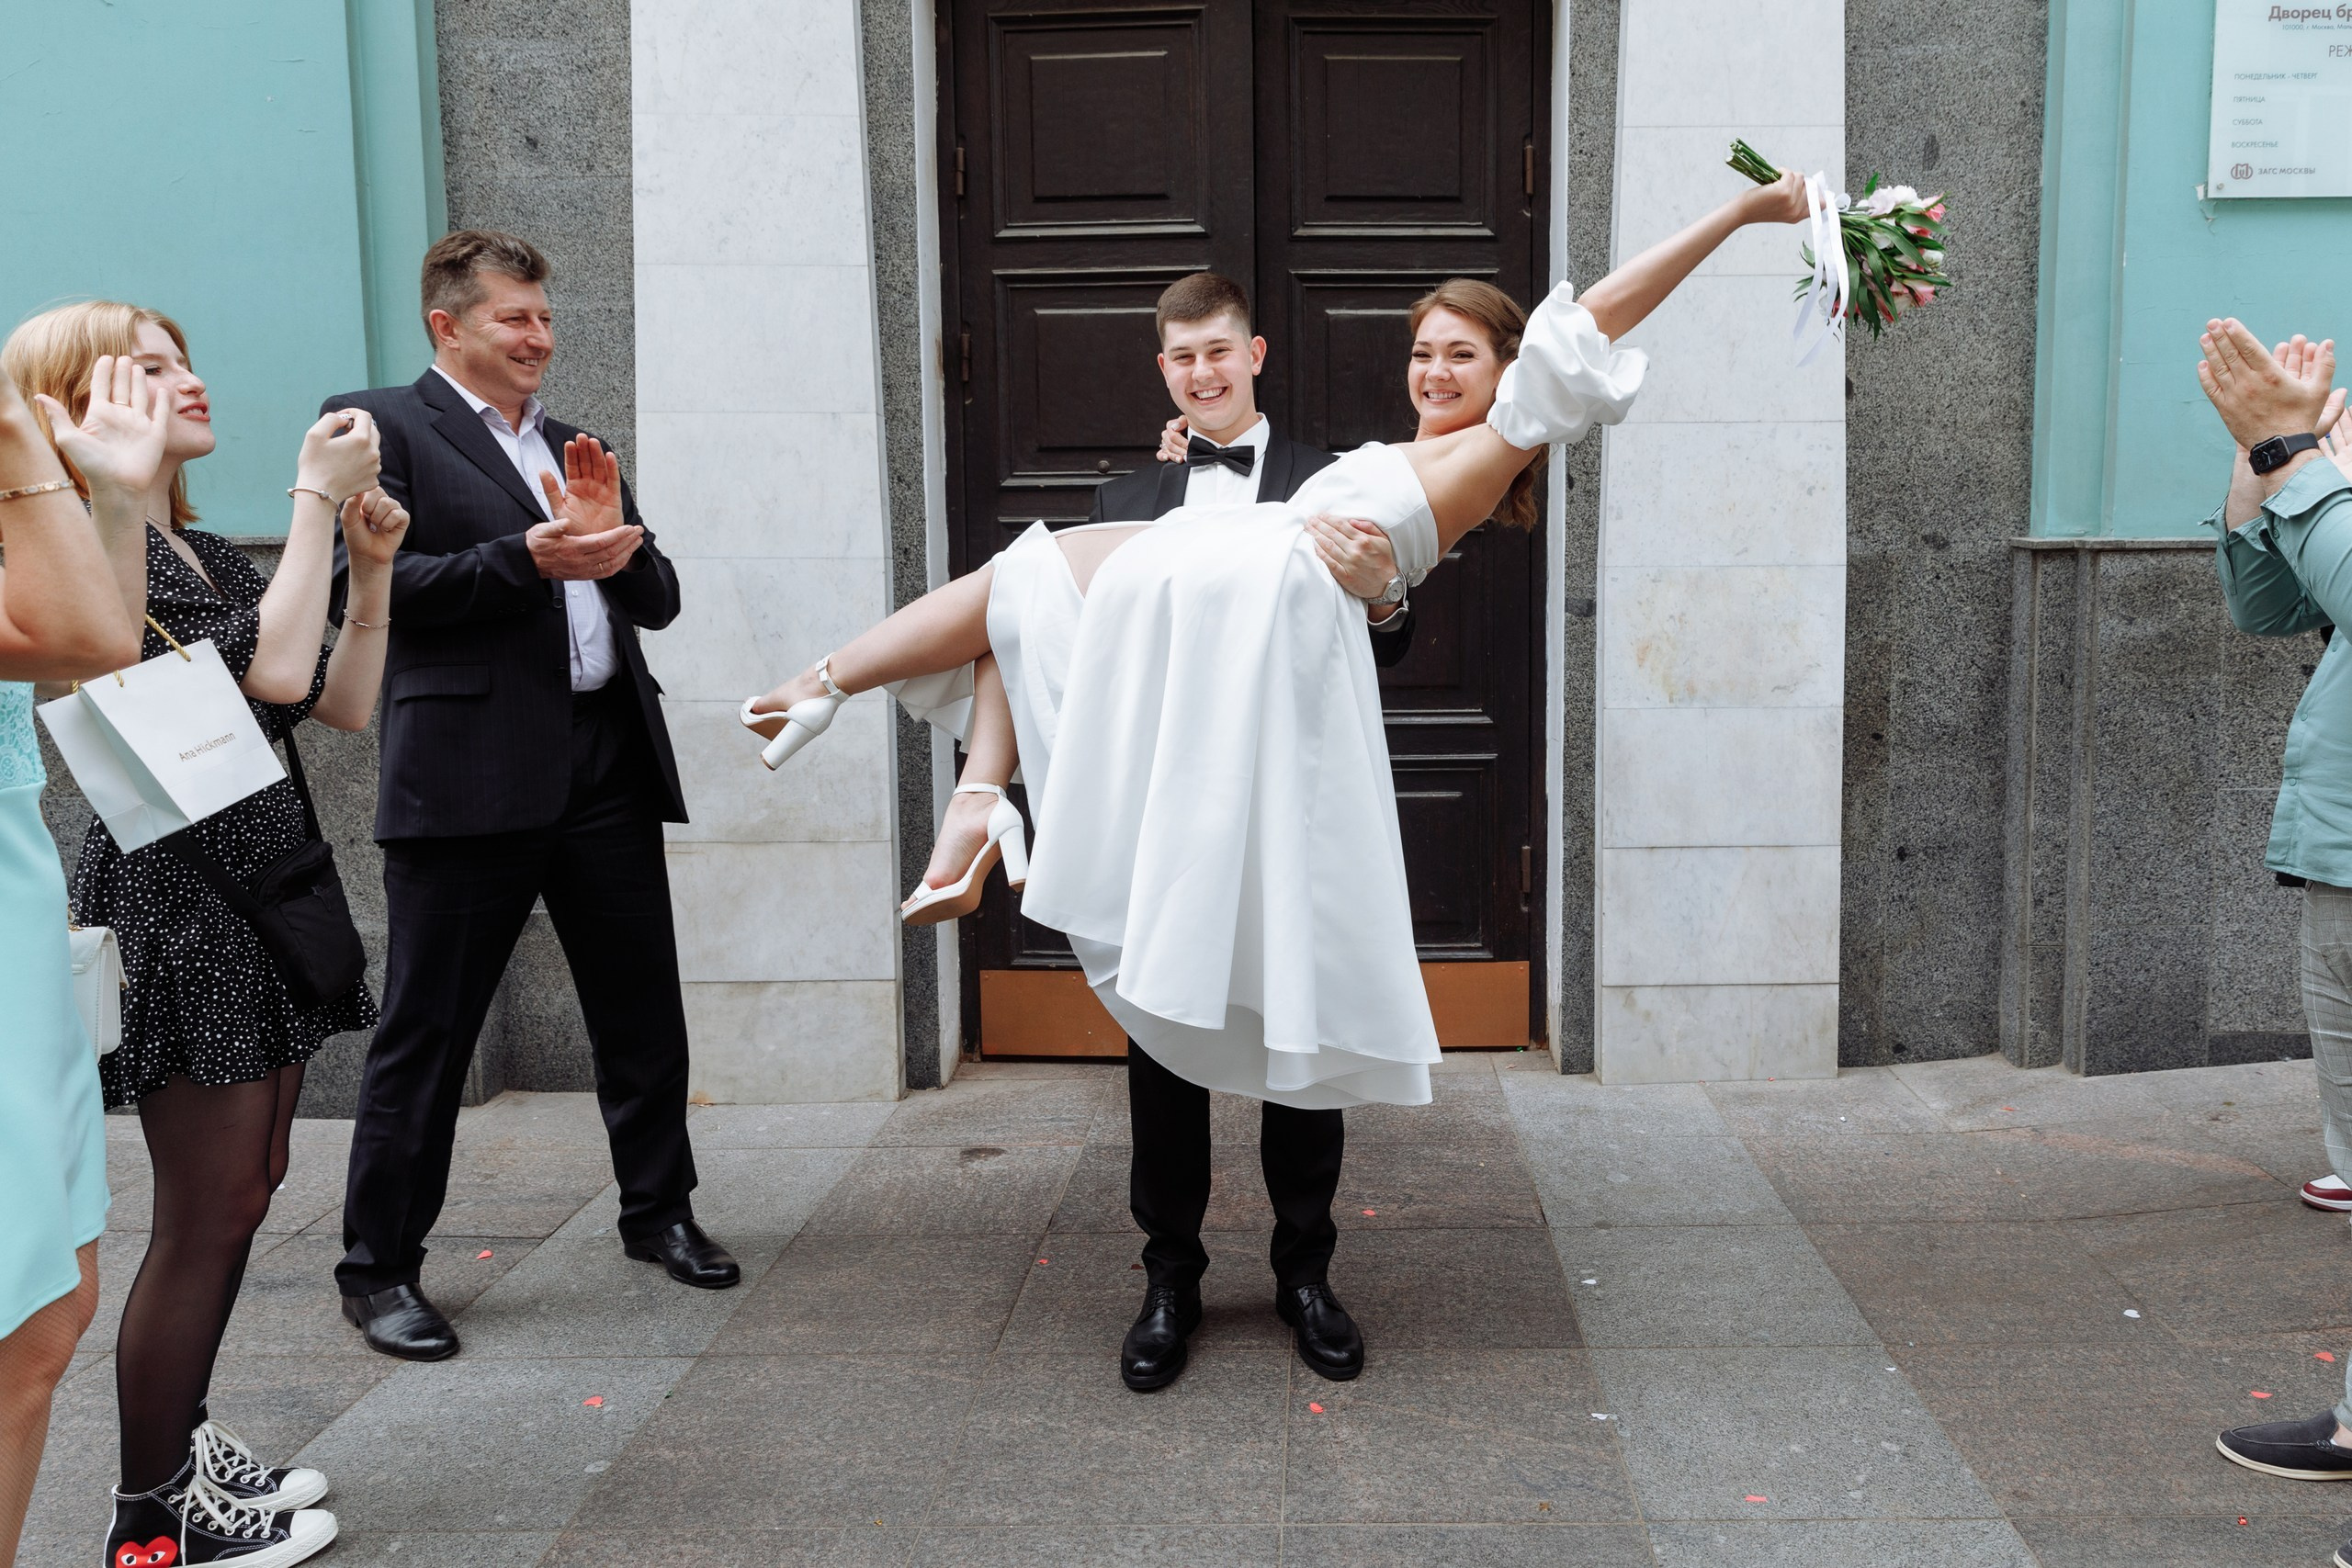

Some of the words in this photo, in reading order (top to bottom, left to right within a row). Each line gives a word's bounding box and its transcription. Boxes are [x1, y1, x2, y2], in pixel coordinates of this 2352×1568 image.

[2268, 6, 2332, 23] Дворец
[179, 750, 198, 761] Ana
[194, 732, 236, 755] Hickmann
